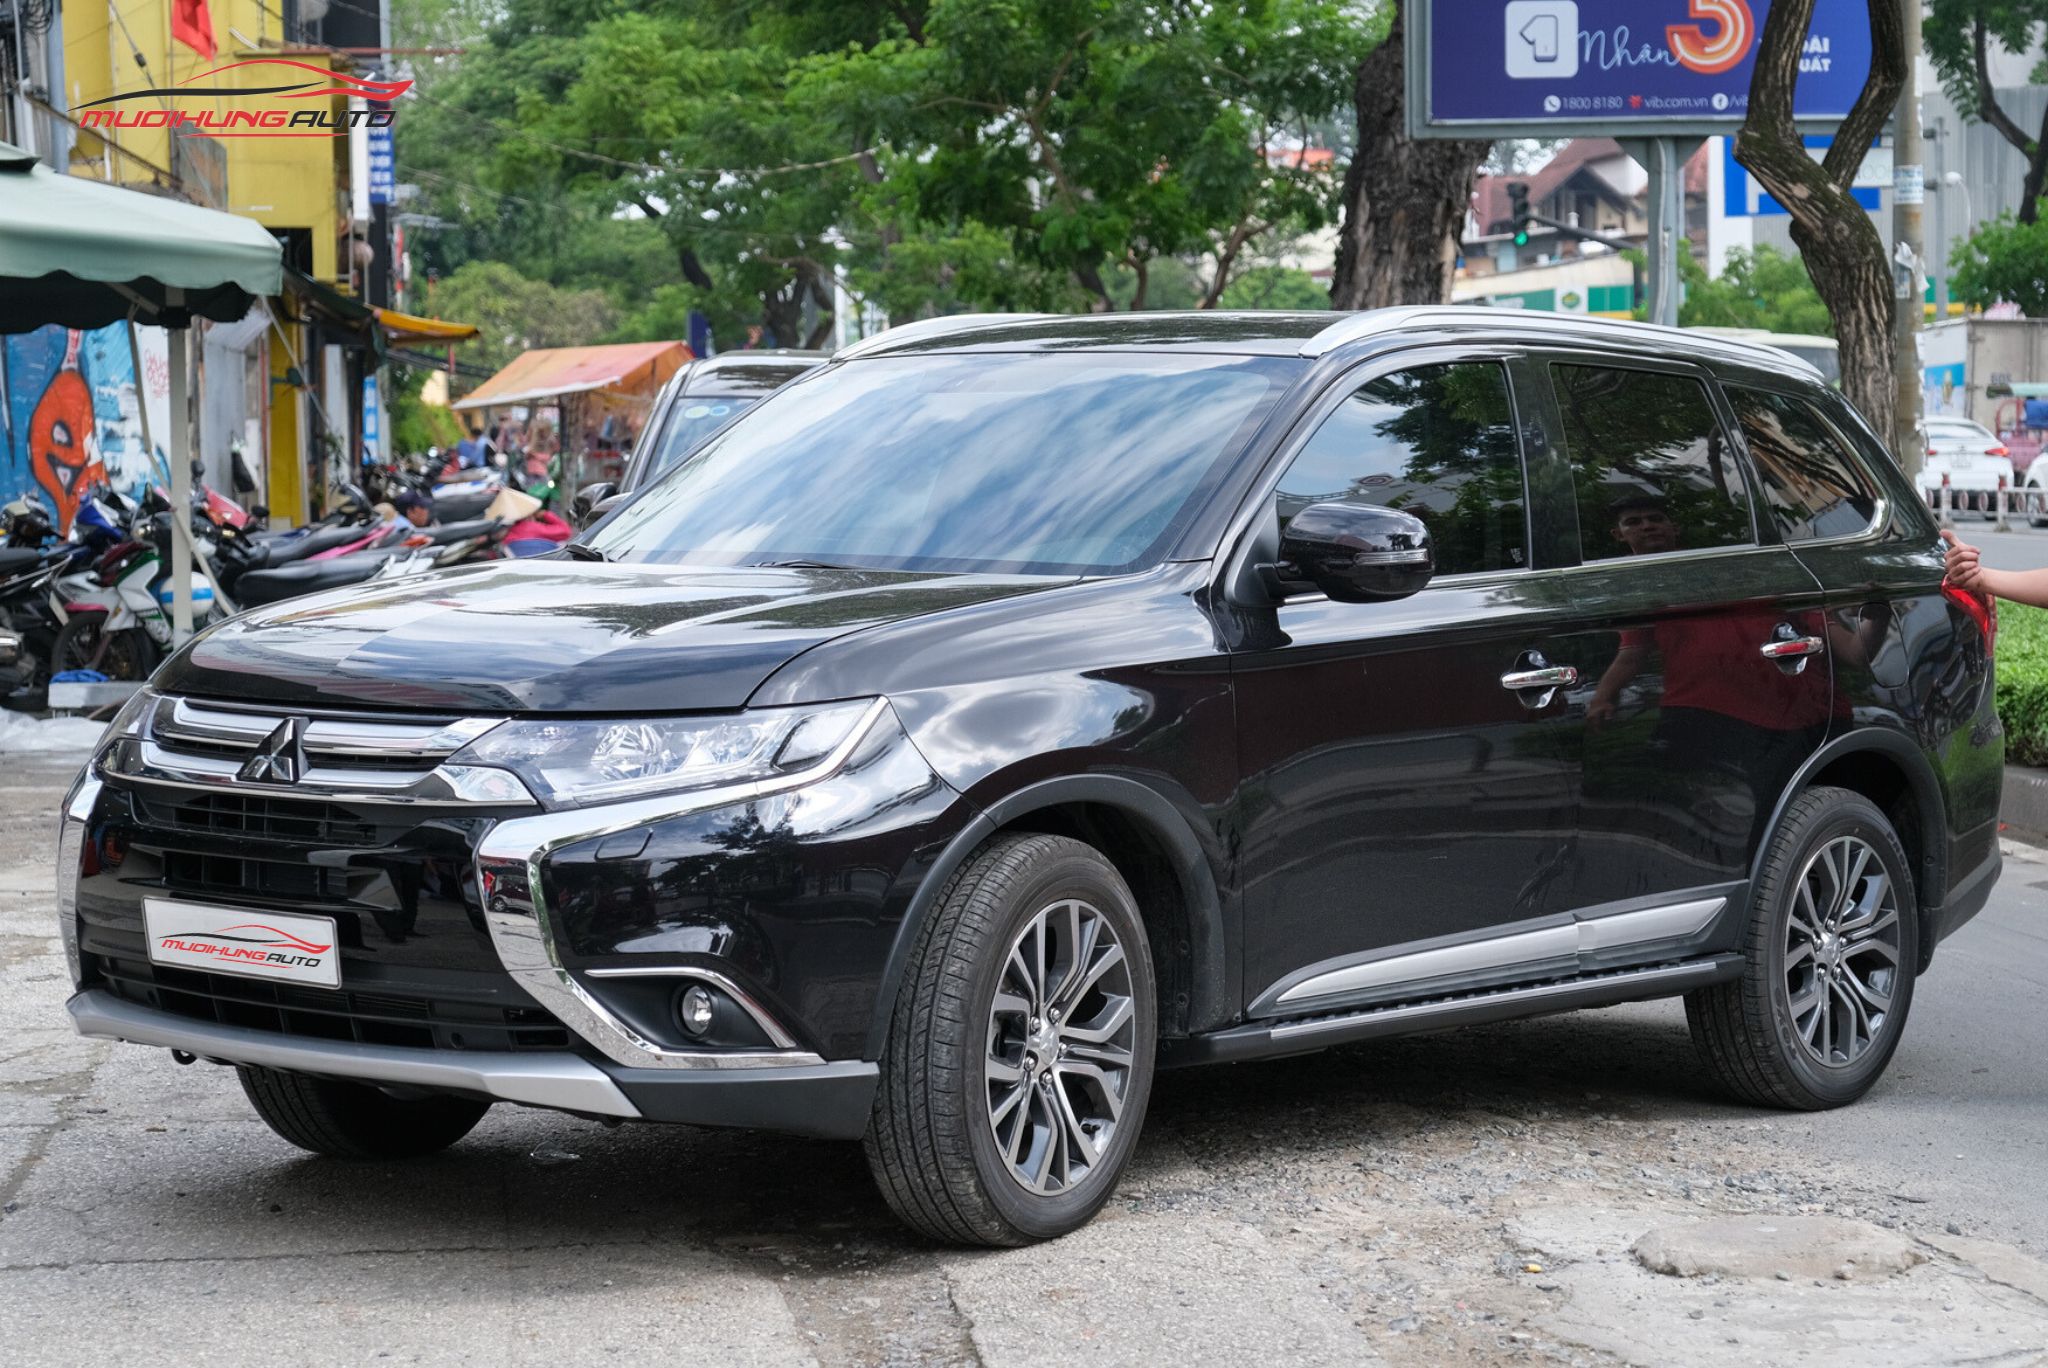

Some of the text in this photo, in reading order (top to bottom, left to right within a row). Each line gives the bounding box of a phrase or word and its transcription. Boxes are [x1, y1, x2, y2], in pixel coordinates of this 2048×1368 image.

[1799, 55, 1832, 73] UẤT
[1562, 96, 1592, 110] 1800
[1592, 95, 1623, 110] 8180
[1644, 95, 1709, 109] vib.com.vn
